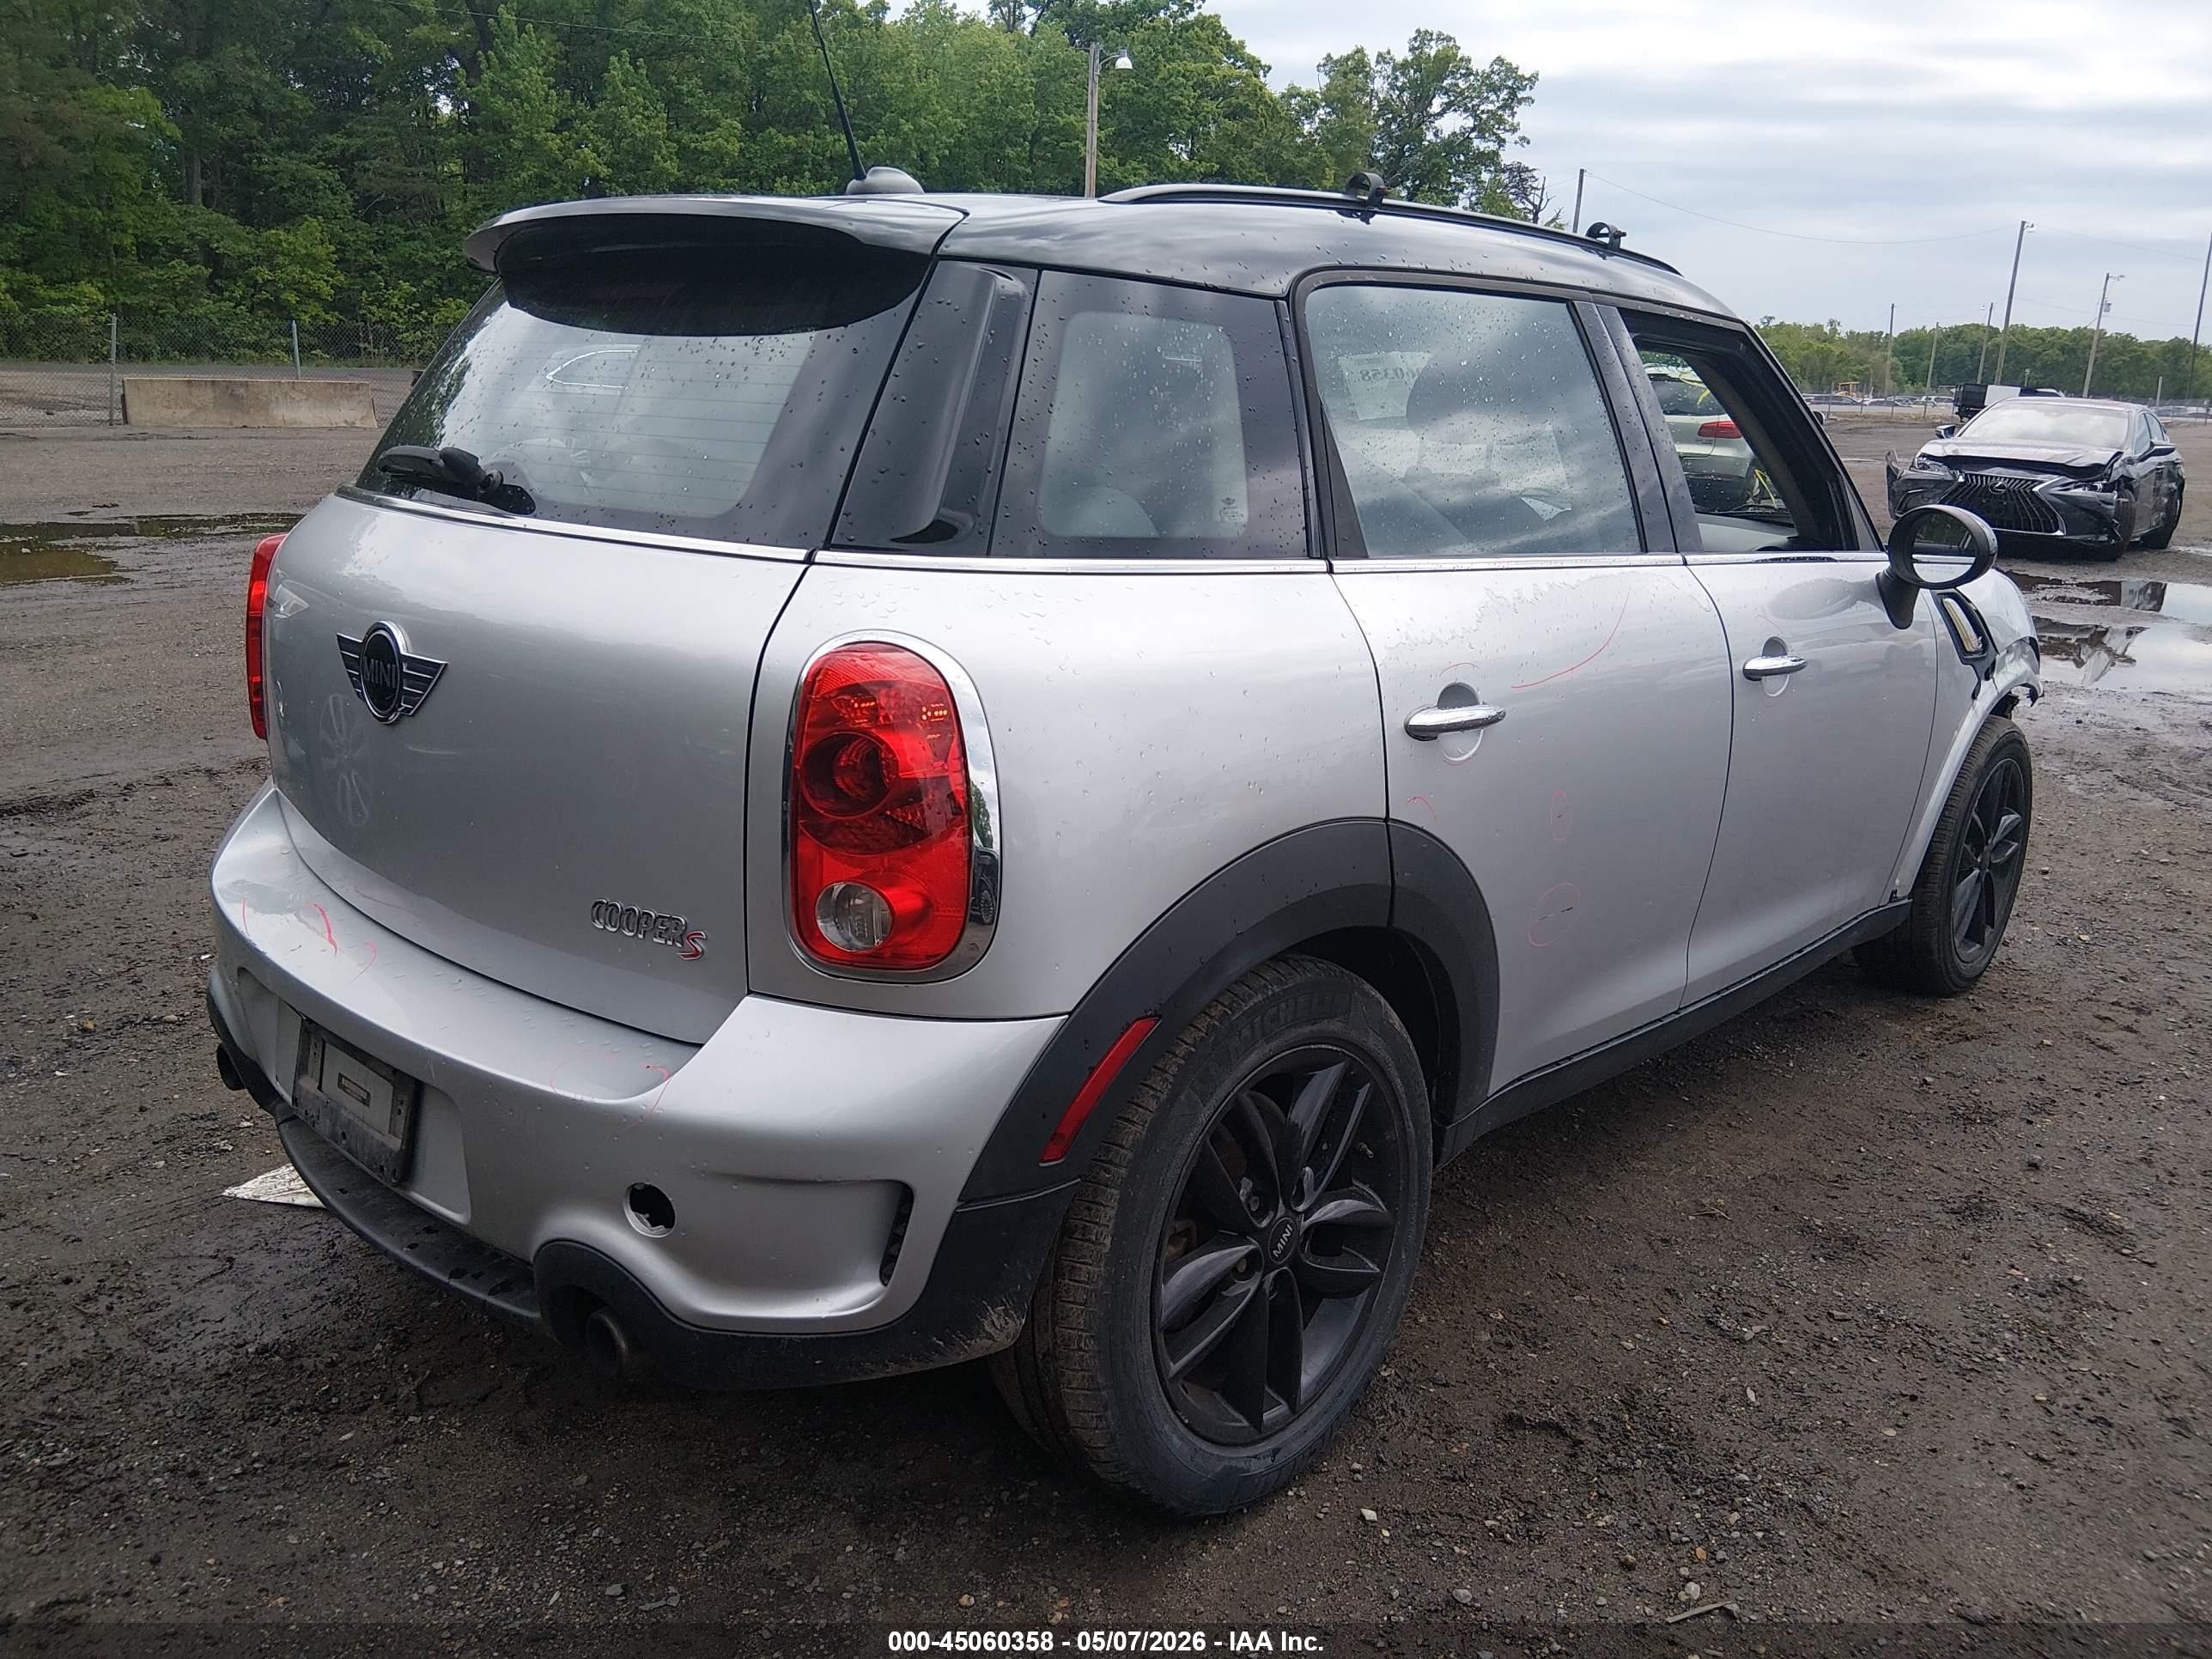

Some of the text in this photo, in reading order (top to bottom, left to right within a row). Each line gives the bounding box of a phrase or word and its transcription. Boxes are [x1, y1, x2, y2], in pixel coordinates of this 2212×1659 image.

[364, 656, 397, 689] MINI
[591, 898, 708, 960] COOPER S
[1228, 990, 1352, 1064] MICHEL
[1273, 1224, 1293, 1258] MINI
